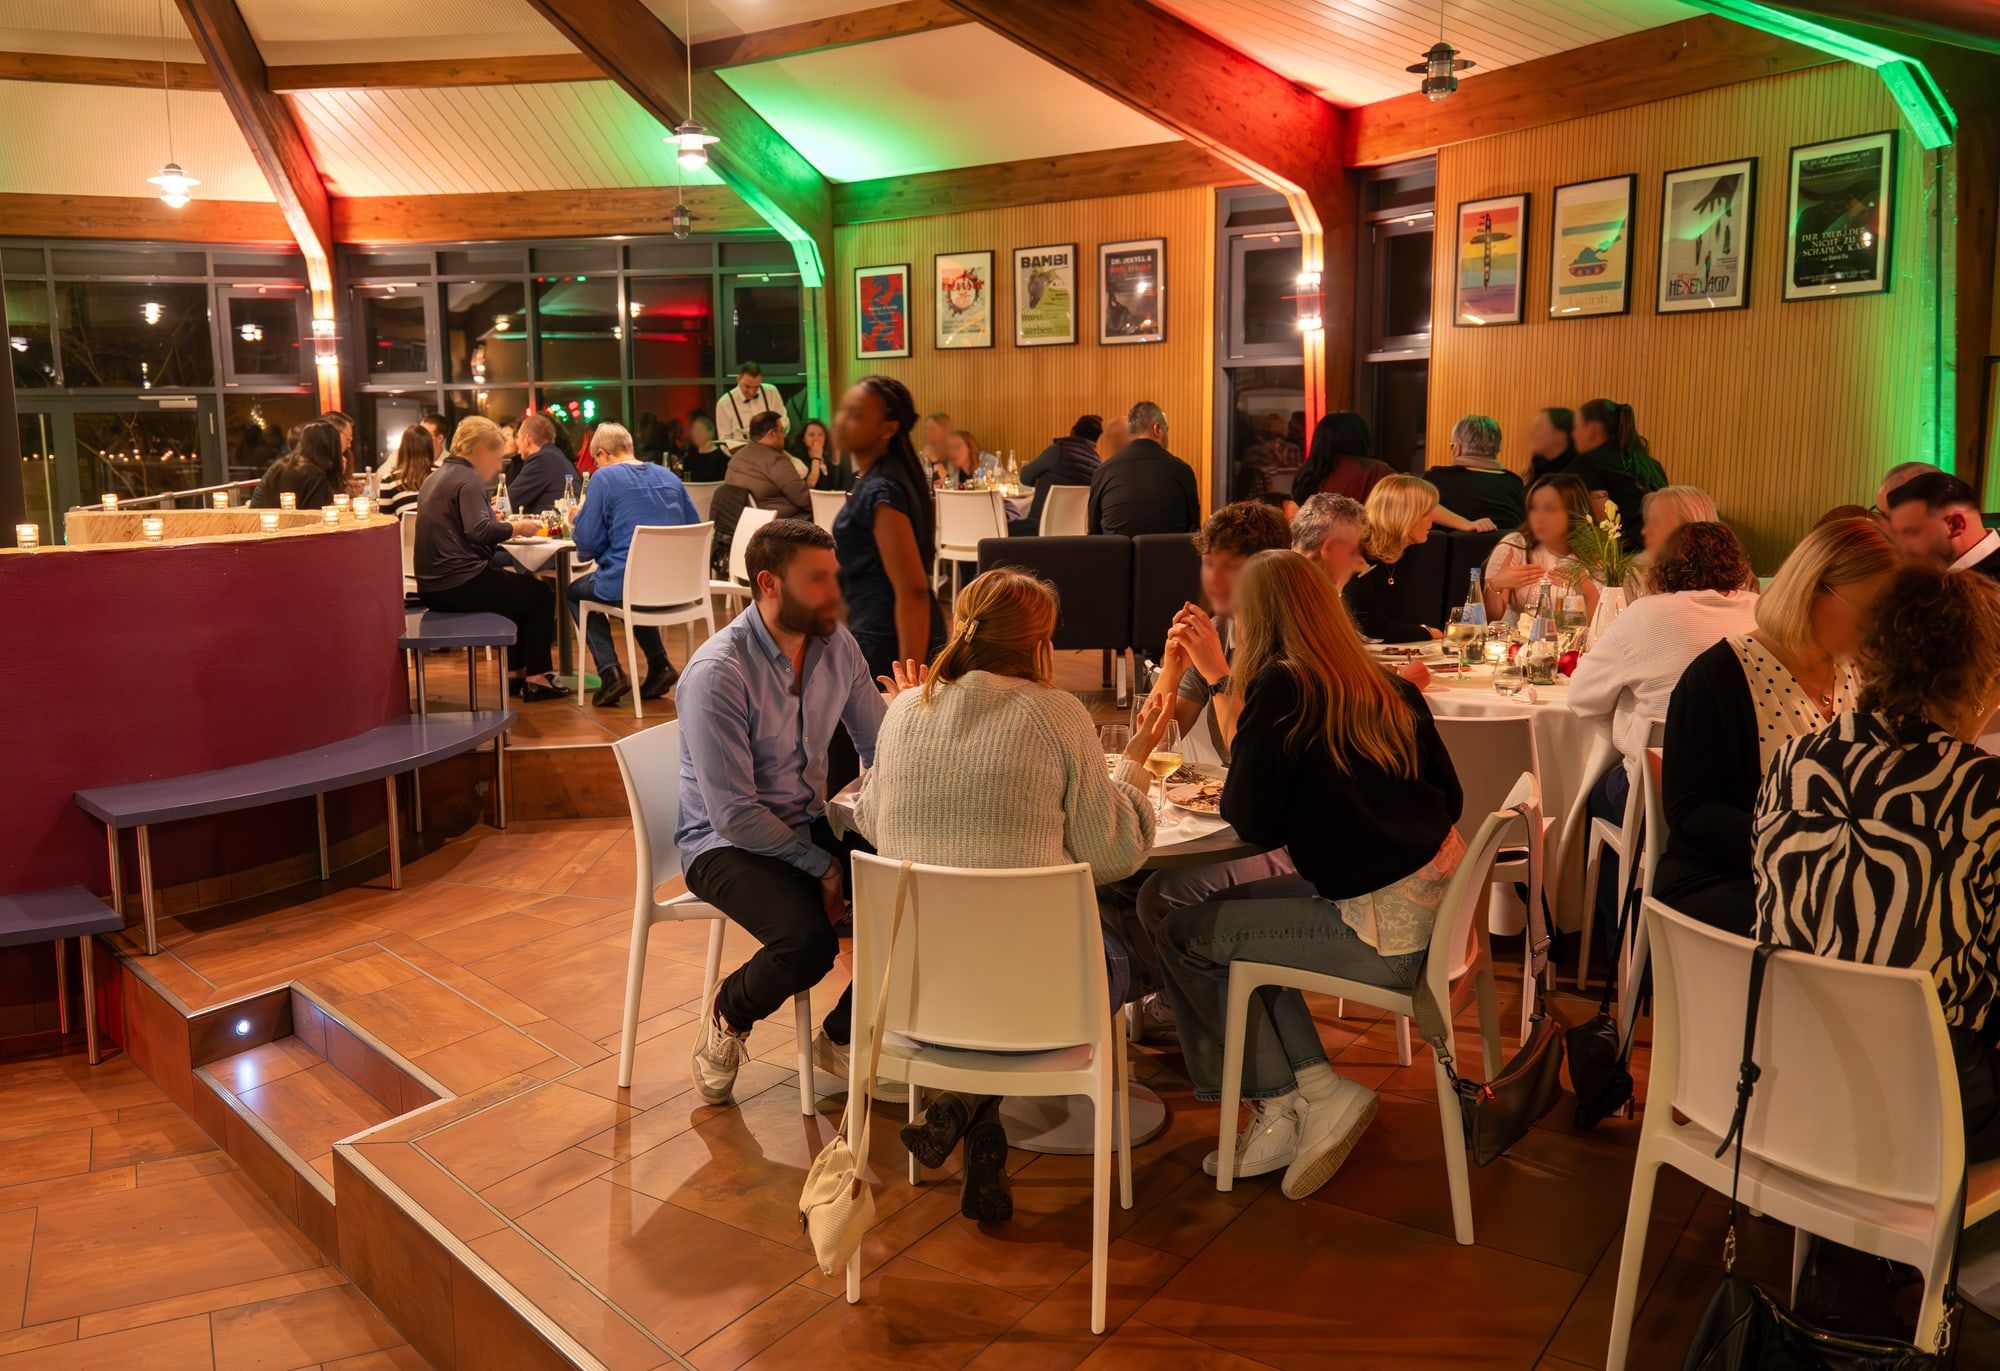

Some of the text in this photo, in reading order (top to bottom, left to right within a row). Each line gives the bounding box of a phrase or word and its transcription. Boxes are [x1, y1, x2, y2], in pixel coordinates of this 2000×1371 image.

[1801, 233, 1818, 242] DER
[1844, 236, 1856, 245] ZU
[1020, 253, 1068, 268] BAMBI
